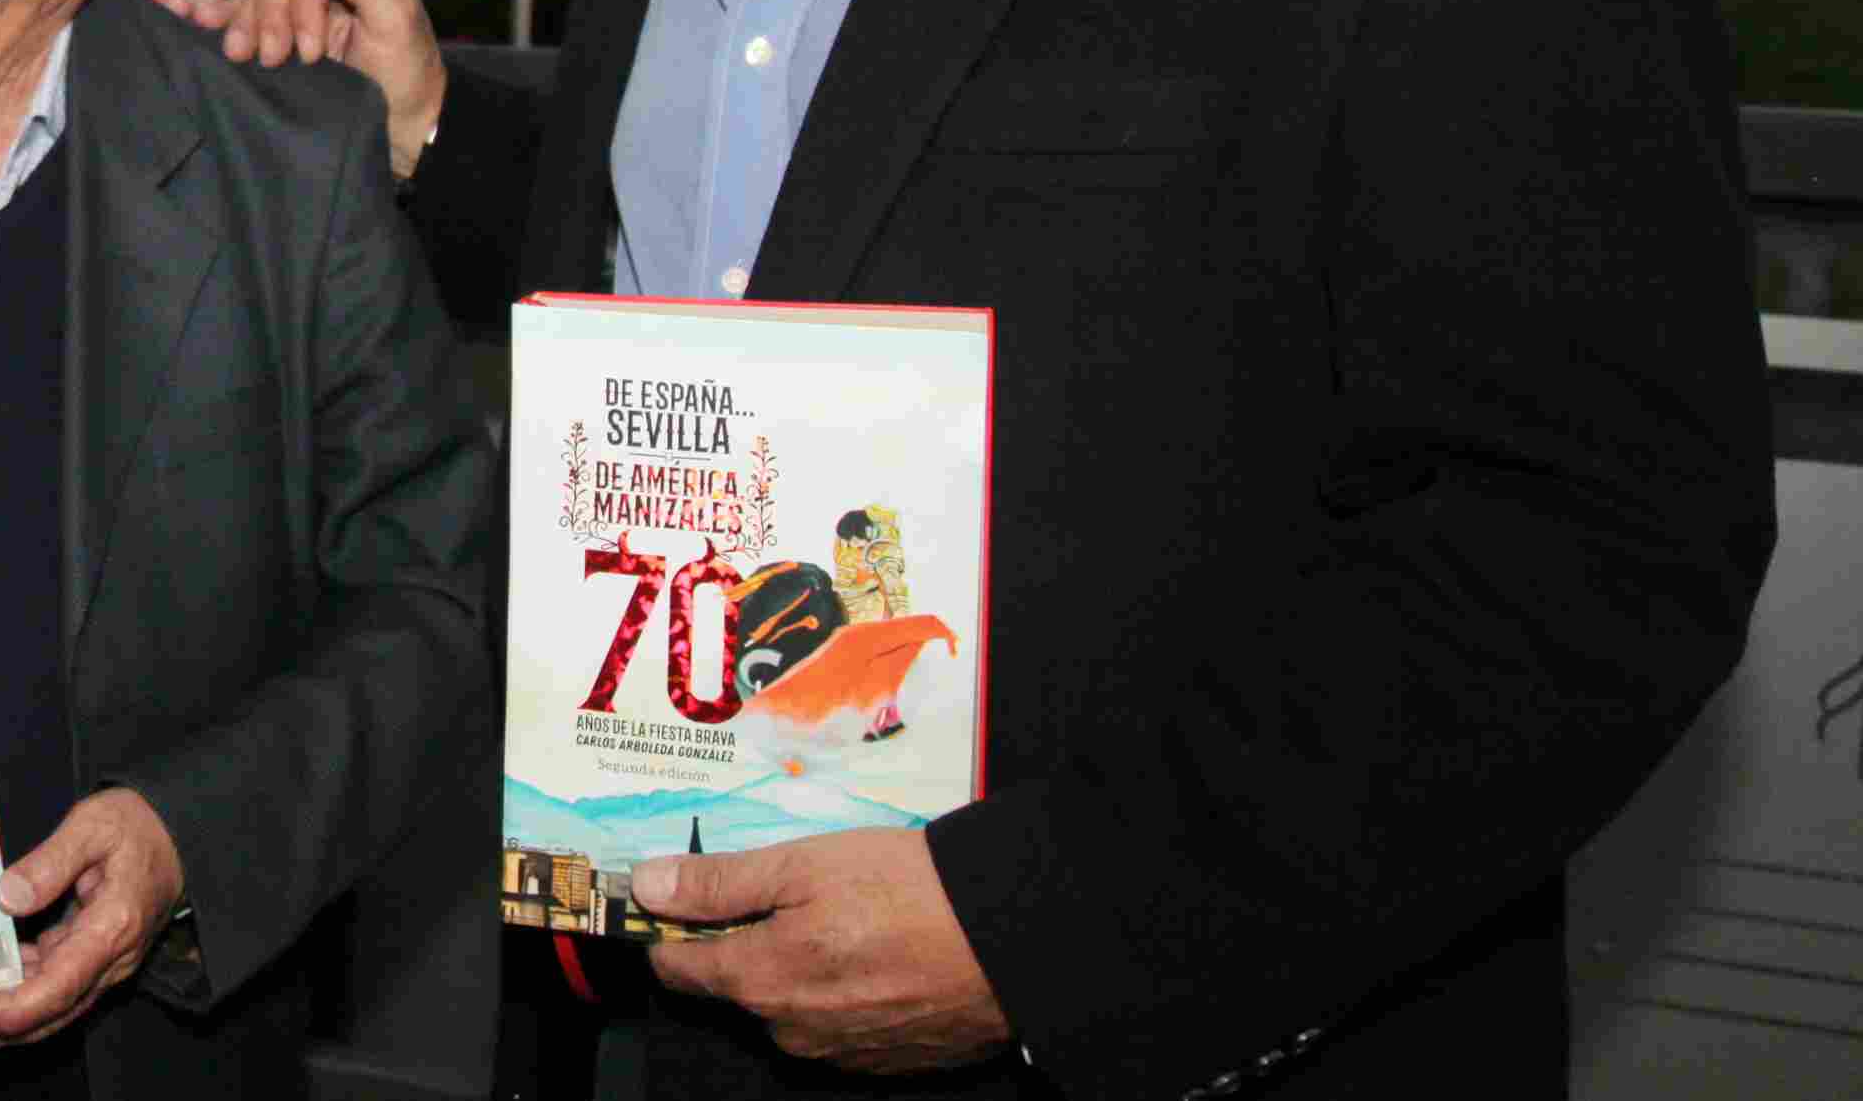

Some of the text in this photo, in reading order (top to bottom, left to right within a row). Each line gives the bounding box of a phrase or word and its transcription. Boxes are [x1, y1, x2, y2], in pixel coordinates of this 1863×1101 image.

[605, 377, 755, 417] DE ESPAÑA...
[606, 408, 730, 454] SEVILLA
[596, 460, 624, 491] DE
[593, 490, 743, 534] MANIZALES
[577, 531, 744, 723] 70
[613, 718, 629, 735] DE
[631, 721, 647, 738] LA
[649, 722, 692, 744] FIESTA
[695, 728, 736, 747] BRAVA
